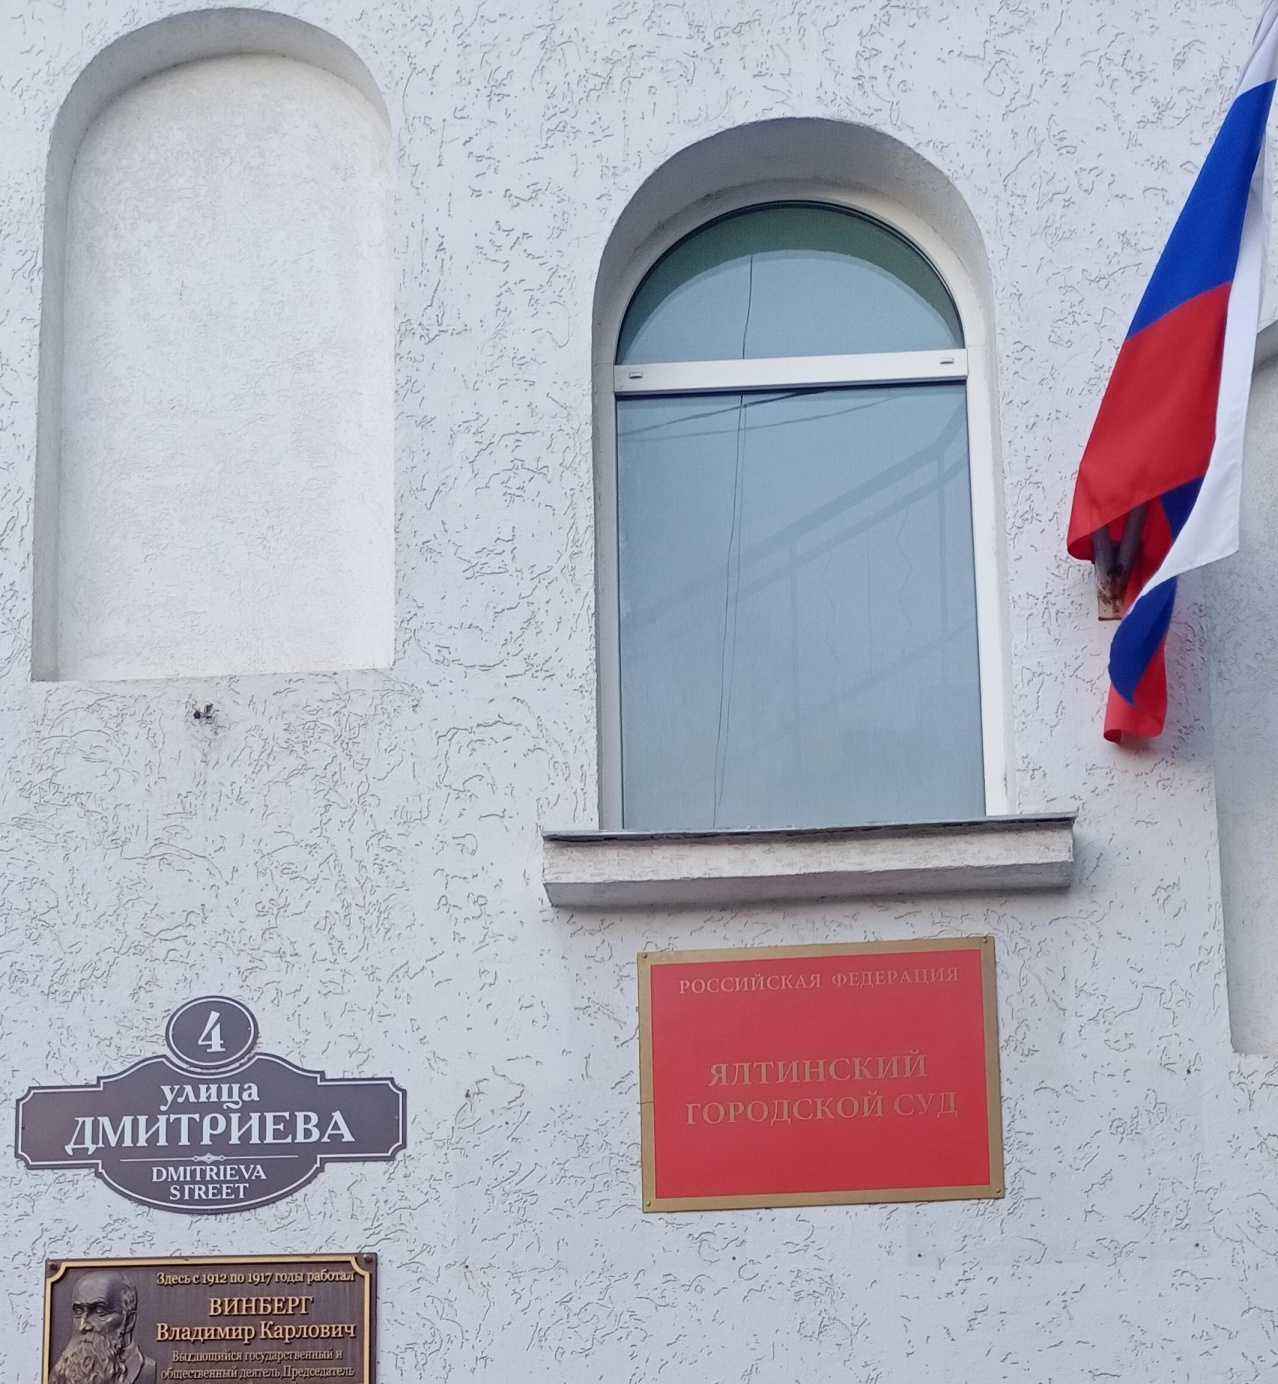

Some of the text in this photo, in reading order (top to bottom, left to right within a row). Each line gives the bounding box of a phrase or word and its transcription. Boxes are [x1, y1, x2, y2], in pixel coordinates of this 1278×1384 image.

[679, 966, 960, 994] РОССИЙСКАЯ ФЕДЕРАЦИЯ
[198, 1010, 226, 1052] 4
[708, 1049, 929, 1087] ЯЛТИНСКИЙ
[160, 1082, 260, 1111] улица
[686, 1090, 958, 1126] ГОРОДСКОЙ СУД
[64, 1109, 356, 1156] ДМИТРИЕВА
[151, 1163, 267, 1182] DMITRIEVA
[169, 1183, 249, 1201] STREET
[157, 1268, 356, 1287] Здесь с 1912 по 1917 годы работал
[209, 1295, 314, 1317] ВИНБЕРГ
[156, 1320, 356, 1344] Владимир Карлович
[245, 1350, 335, 1363] государственный
[161, 1366, 239, 1381] общественный
[283, 1364, 356, 1379] Председатель
